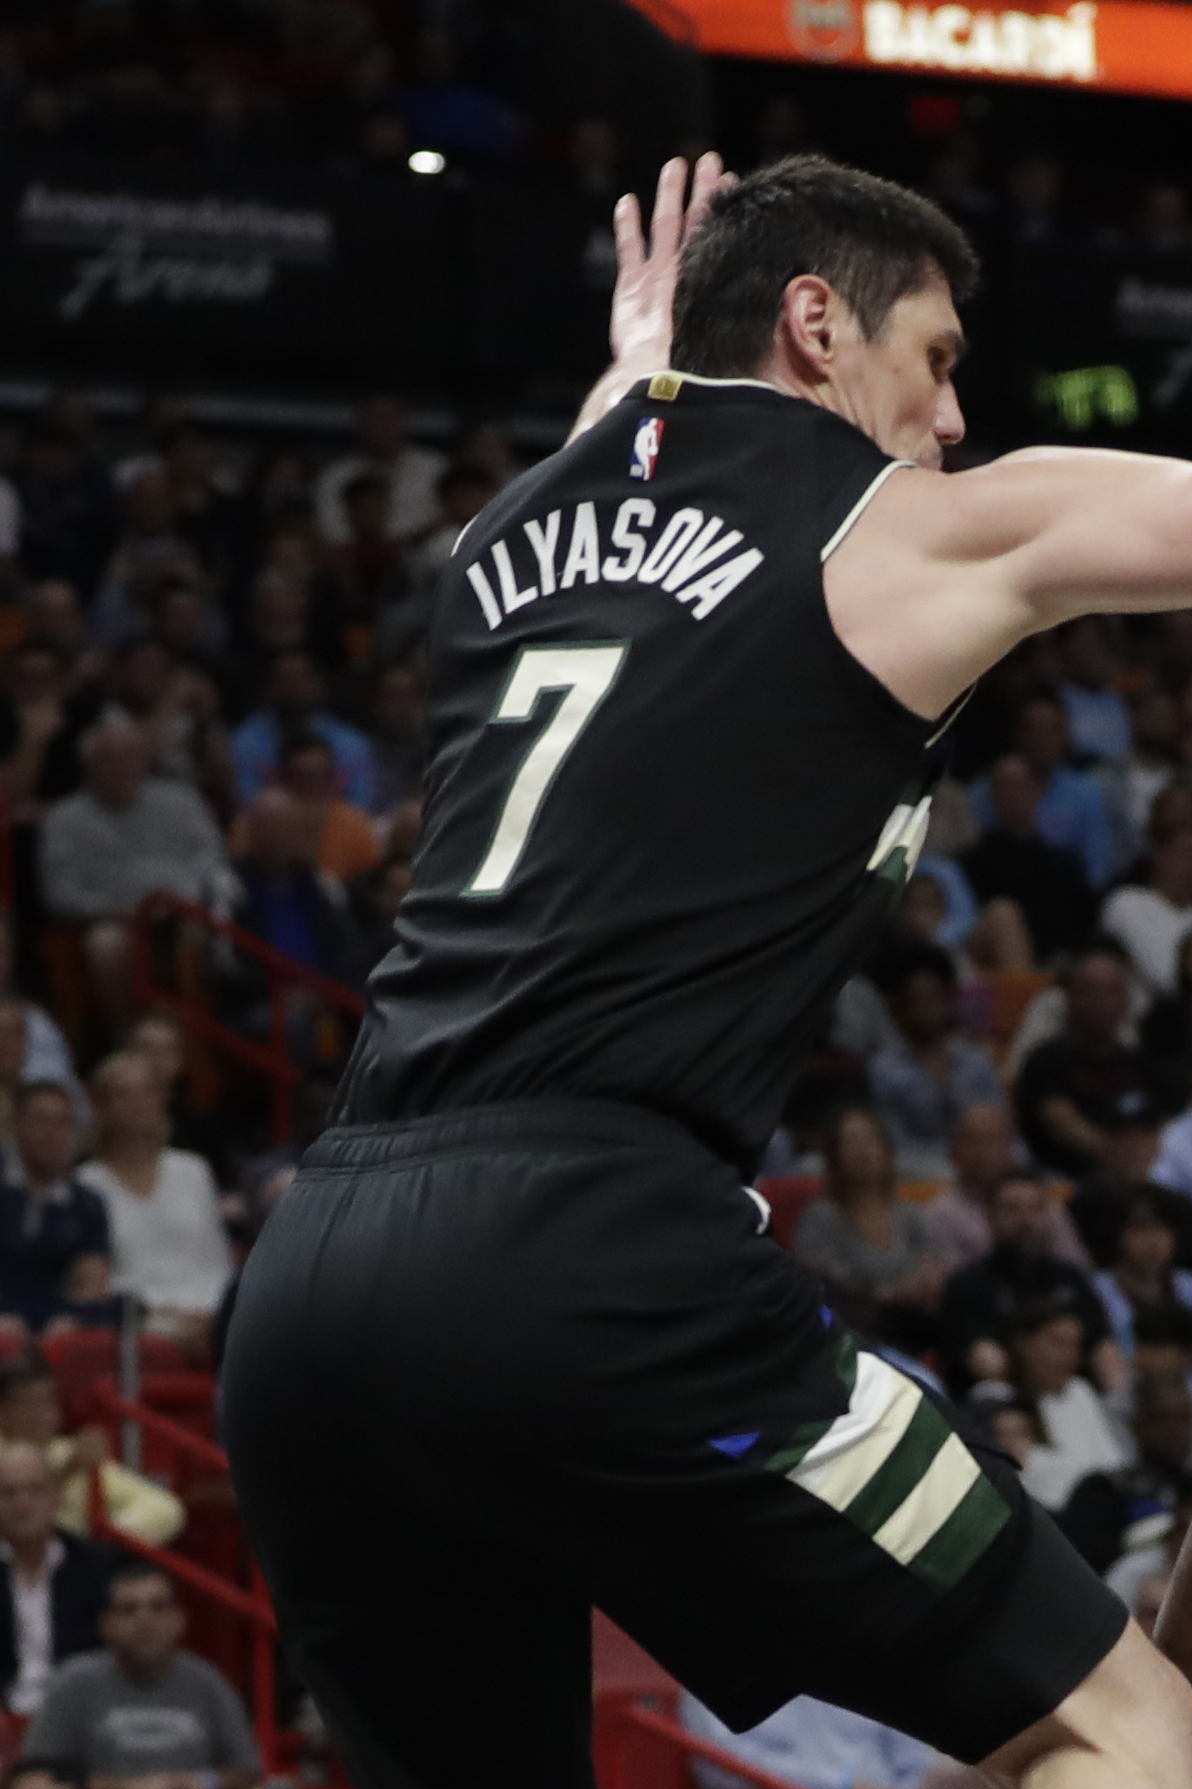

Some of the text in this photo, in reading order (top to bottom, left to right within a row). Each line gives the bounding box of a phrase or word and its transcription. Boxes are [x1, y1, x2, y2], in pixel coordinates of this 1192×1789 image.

[863, 0, 1098, 82] BACARDÍ
[466, 497, 764, 630] ILYASOVA
[460, 638, 632, 897] 7
